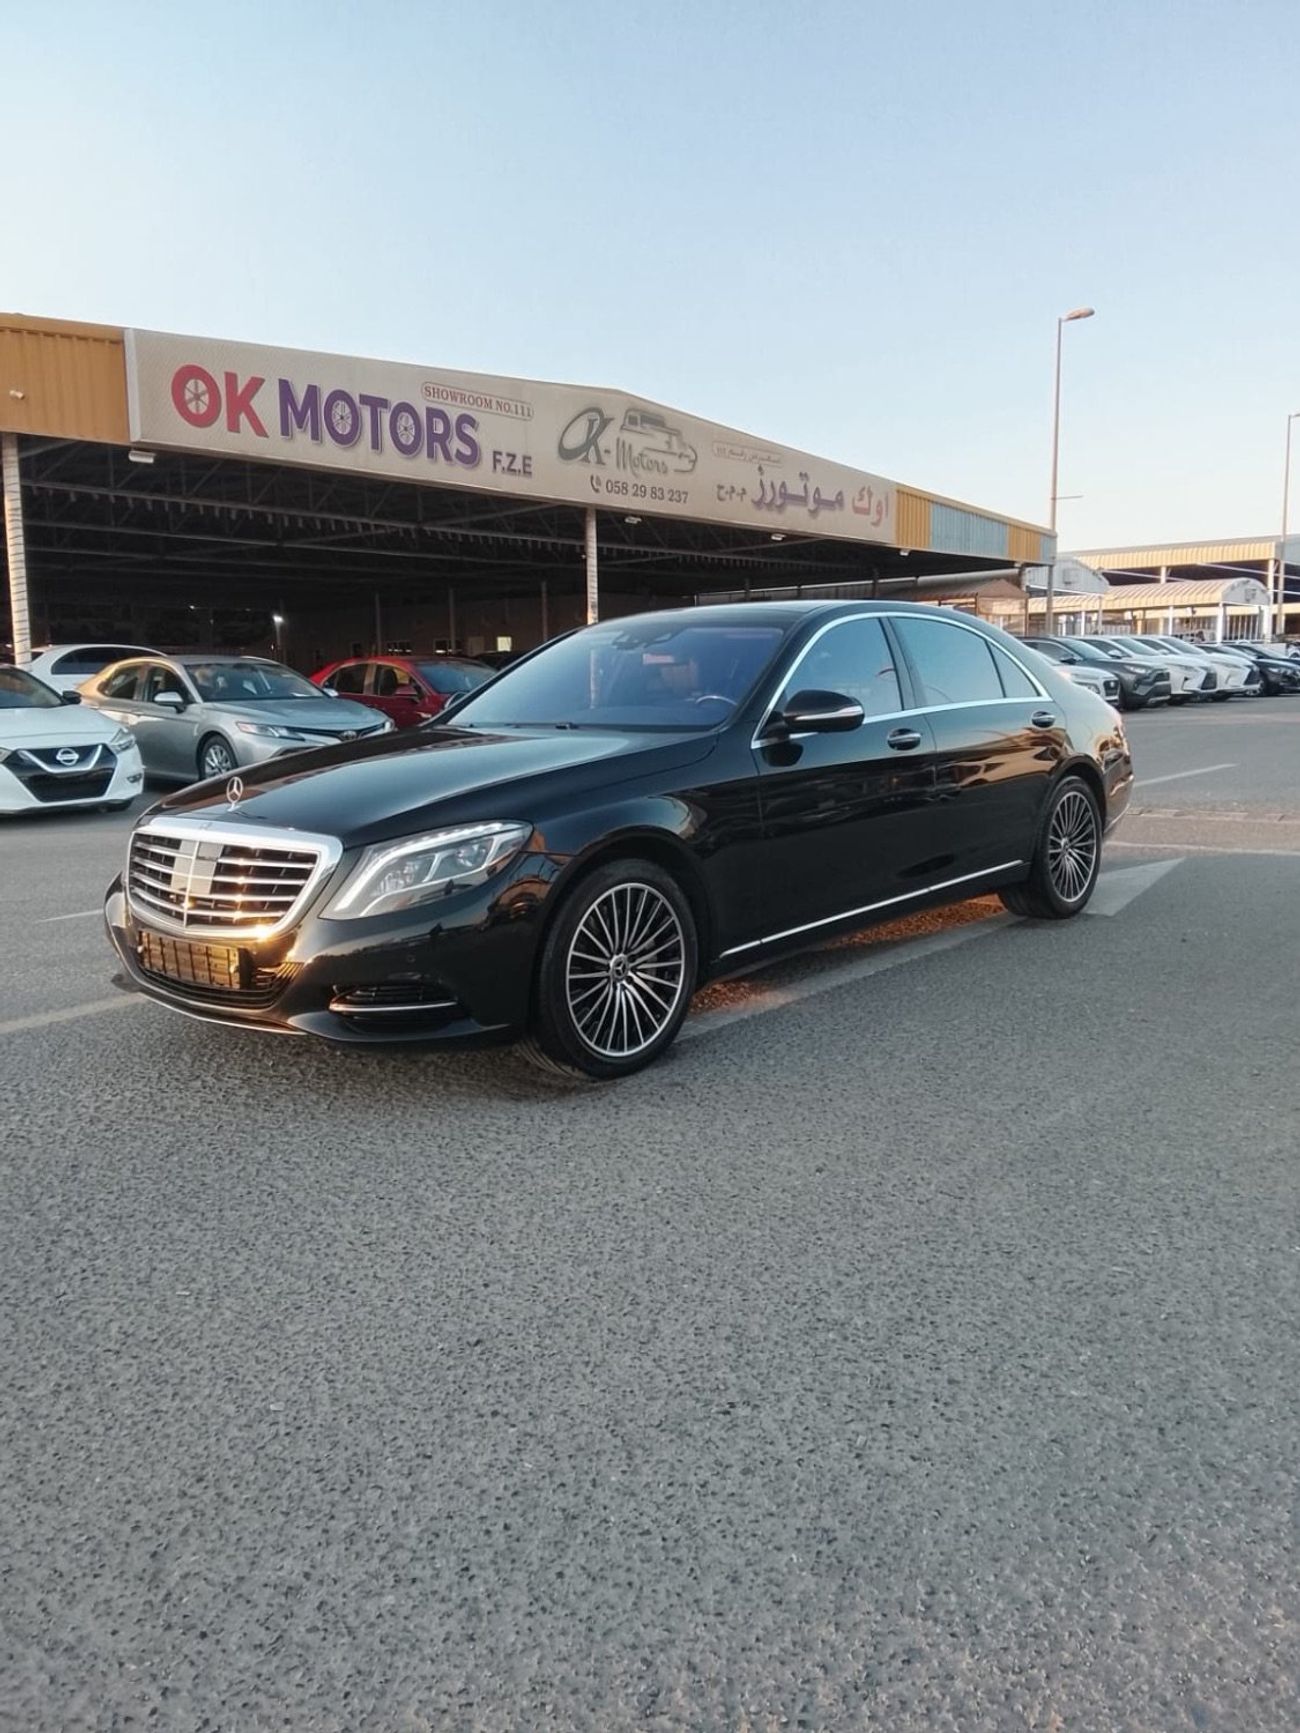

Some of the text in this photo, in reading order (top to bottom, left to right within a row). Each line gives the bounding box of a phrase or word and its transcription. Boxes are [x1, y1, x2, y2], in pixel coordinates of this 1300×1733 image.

[424, 386, 493, 409] SHOWROOM
[171, 364, 480, 467] OK MOTORS
[492, 451, 532, 475] F.Z.E
[606, 479, 689, 504] 058 29 83 237
[751, 464, 844, 515] موتورز
